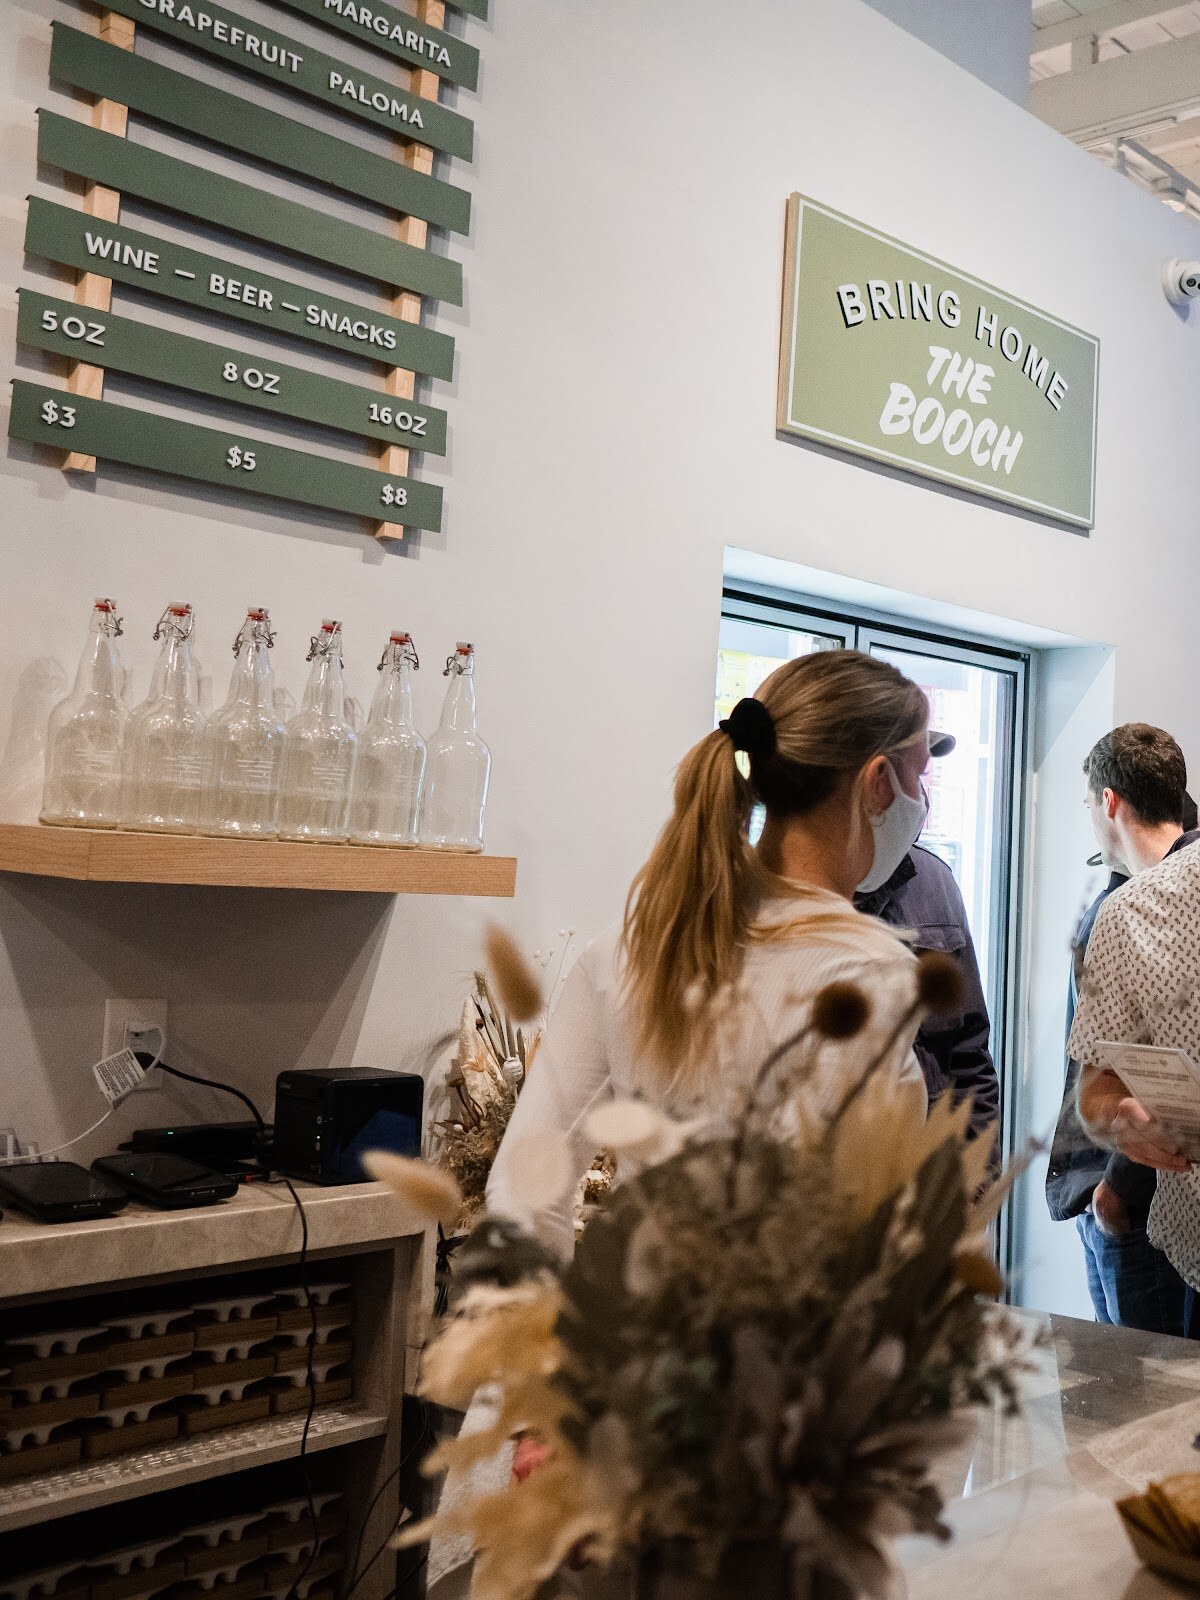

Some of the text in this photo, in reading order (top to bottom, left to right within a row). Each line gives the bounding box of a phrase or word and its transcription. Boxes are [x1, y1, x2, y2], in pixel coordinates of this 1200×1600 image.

[324, 0, 452, 68] MARGARITA
[329, 71, 424, 129] PALOMA
[85, 232, 159, 275] WINE
[209, 273, 273, 312] BEER
[306, 304, 397, 350] SNACKS
[836, 279, 1069, 411] BRING HOME
[928, 345, 996, 404] THE
[41, 400, 408, 506] $3 $5 $8
[879, 382, 1024, 475] BOOCH
